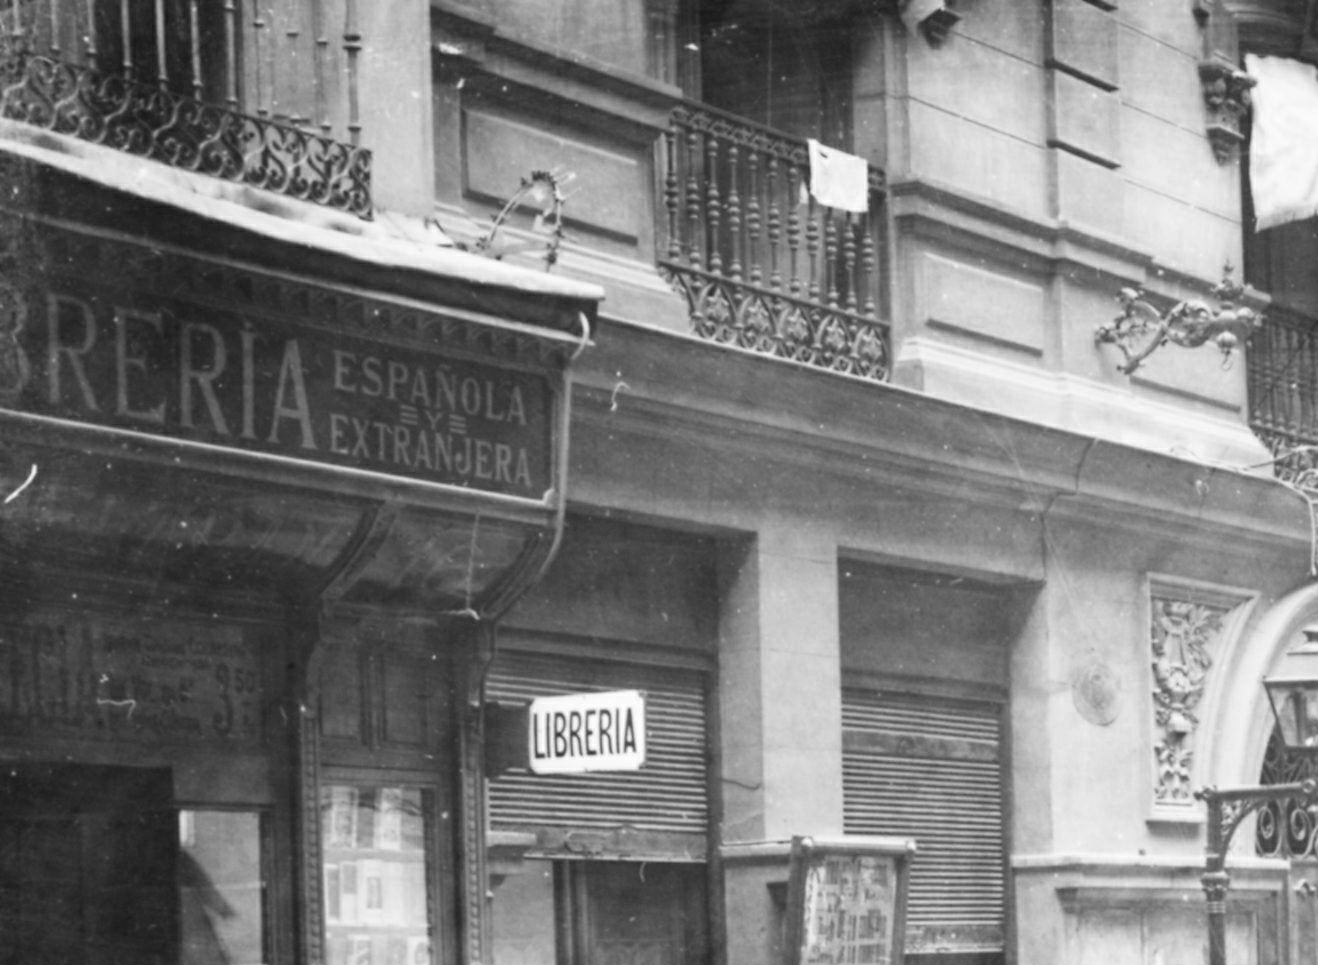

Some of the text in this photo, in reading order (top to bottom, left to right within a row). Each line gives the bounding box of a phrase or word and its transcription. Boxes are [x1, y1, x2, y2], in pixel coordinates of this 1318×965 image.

[333, 350, 527, 425] ESPAÑOLA
[329, 413, 531, 487] EXTRANJERA
[425, 410, 444, 430] Y
[533, 707, 637, 760] LIBRERIA
